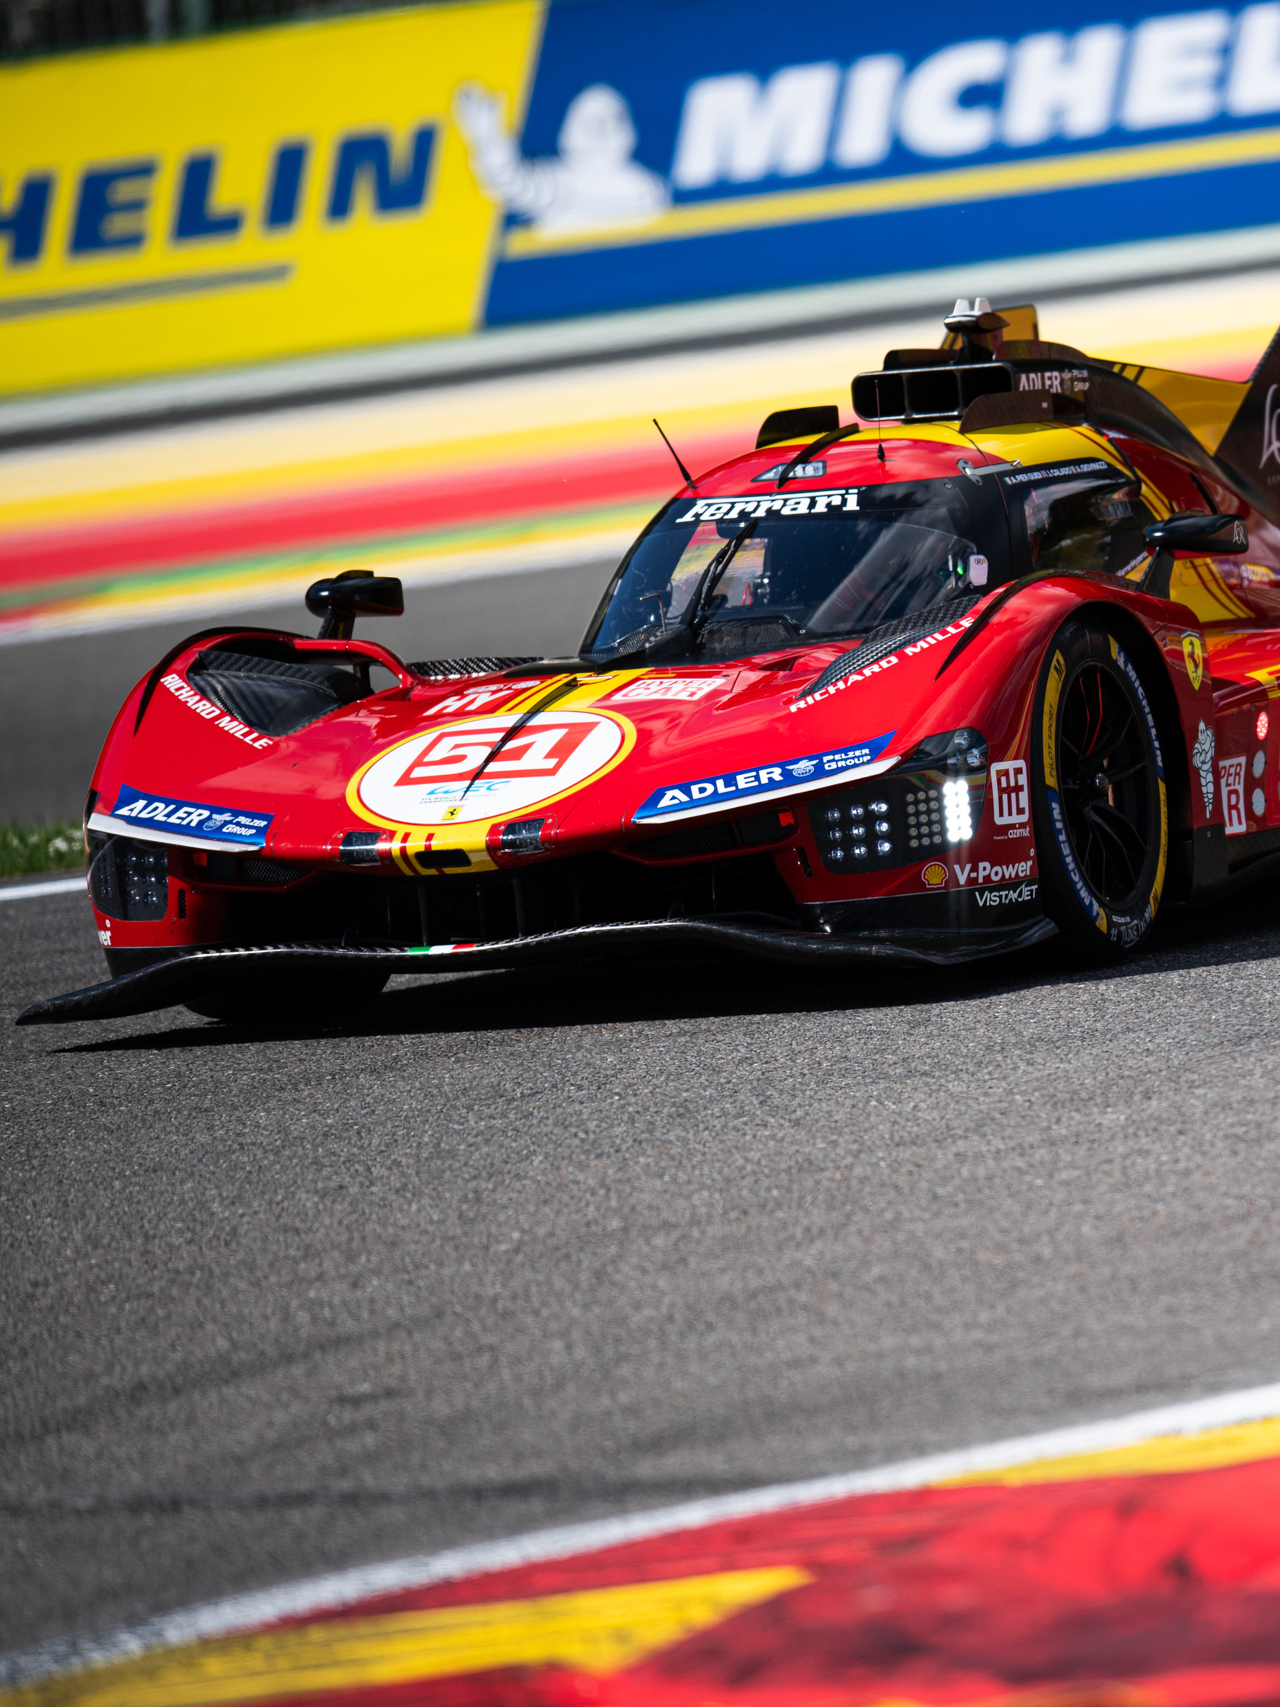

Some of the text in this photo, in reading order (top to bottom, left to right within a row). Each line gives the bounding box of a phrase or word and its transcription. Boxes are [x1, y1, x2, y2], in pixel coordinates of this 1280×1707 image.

[675, 488, 862, 524] Ferrari
[789, 616, 975, 713] RICHARD MILLE
[620, 686, 705, 698] CAR
[635, 680, 717, 688] HYPER
[160, 673, 274, 750] RICHARD MILLE
[422, 690, 515, 716] HY
[1125, 662, 1163, 768] MICHELIN
[409, 728, 570, 778] 51
[823, 748, 870, 763] PELZER
[824, 755, 871, 771] GROUP
[425, 780, 513, 796] WEC
[657, 767, 784, 808] ADLER
[1220, 762, 1243, 788] PER
[114, 799, 210, 827] ADLER
[1225, 788, 1243, 828] R
[222, 824, 256, 836] GROUP
[232, 815, 267, 828] PELZER
[1008, 823, 1030, 838] azimut
[1051, 801, 1091, 906] MICHELIN
[953, 860, 1033, 885] V-Power
